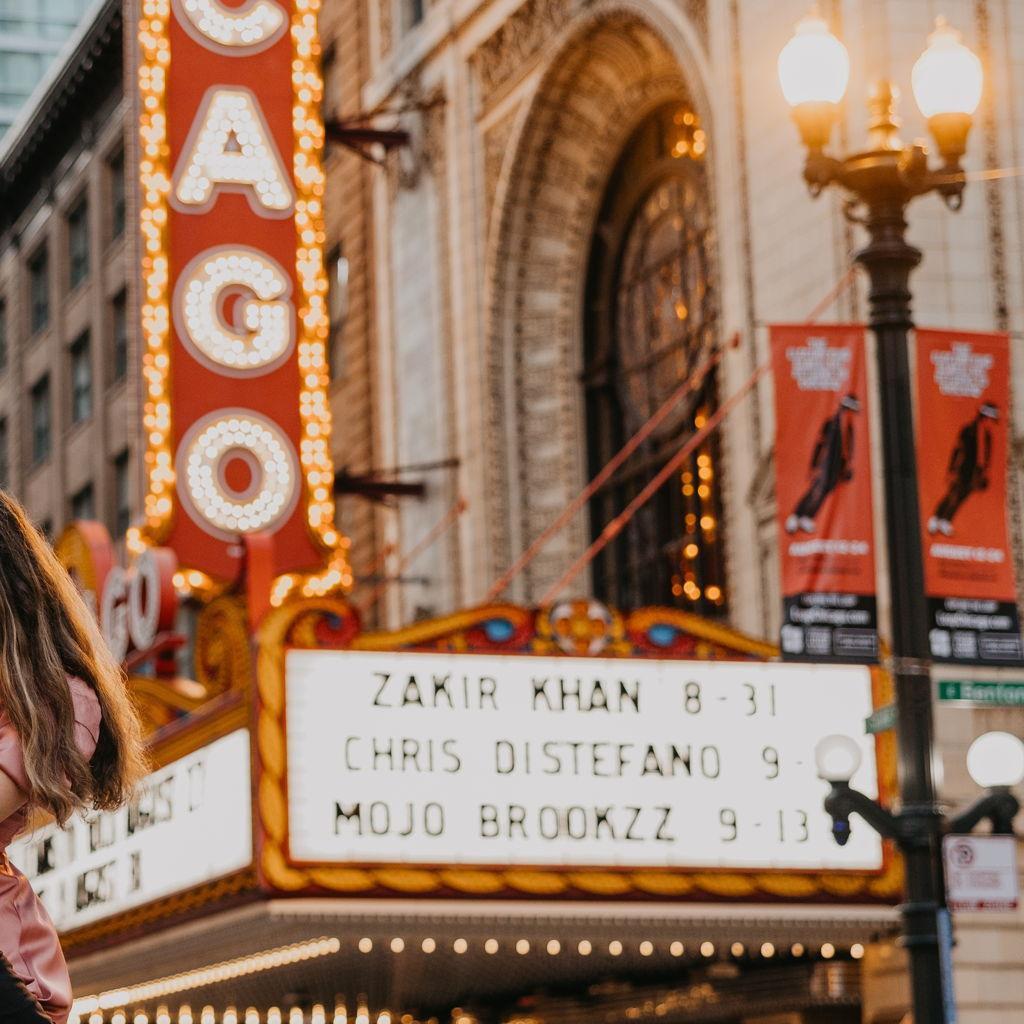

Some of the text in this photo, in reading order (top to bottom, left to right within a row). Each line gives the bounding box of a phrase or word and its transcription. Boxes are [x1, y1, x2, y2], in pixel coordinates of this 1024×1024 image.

[371, 671, 777, 718] ZAKIR KHAN 8-31
[343, 736, 806, 781] CHRIS DISTEFANO 9-
[333, 799, 810, 844] MOJO BROOKZZ 9-13
